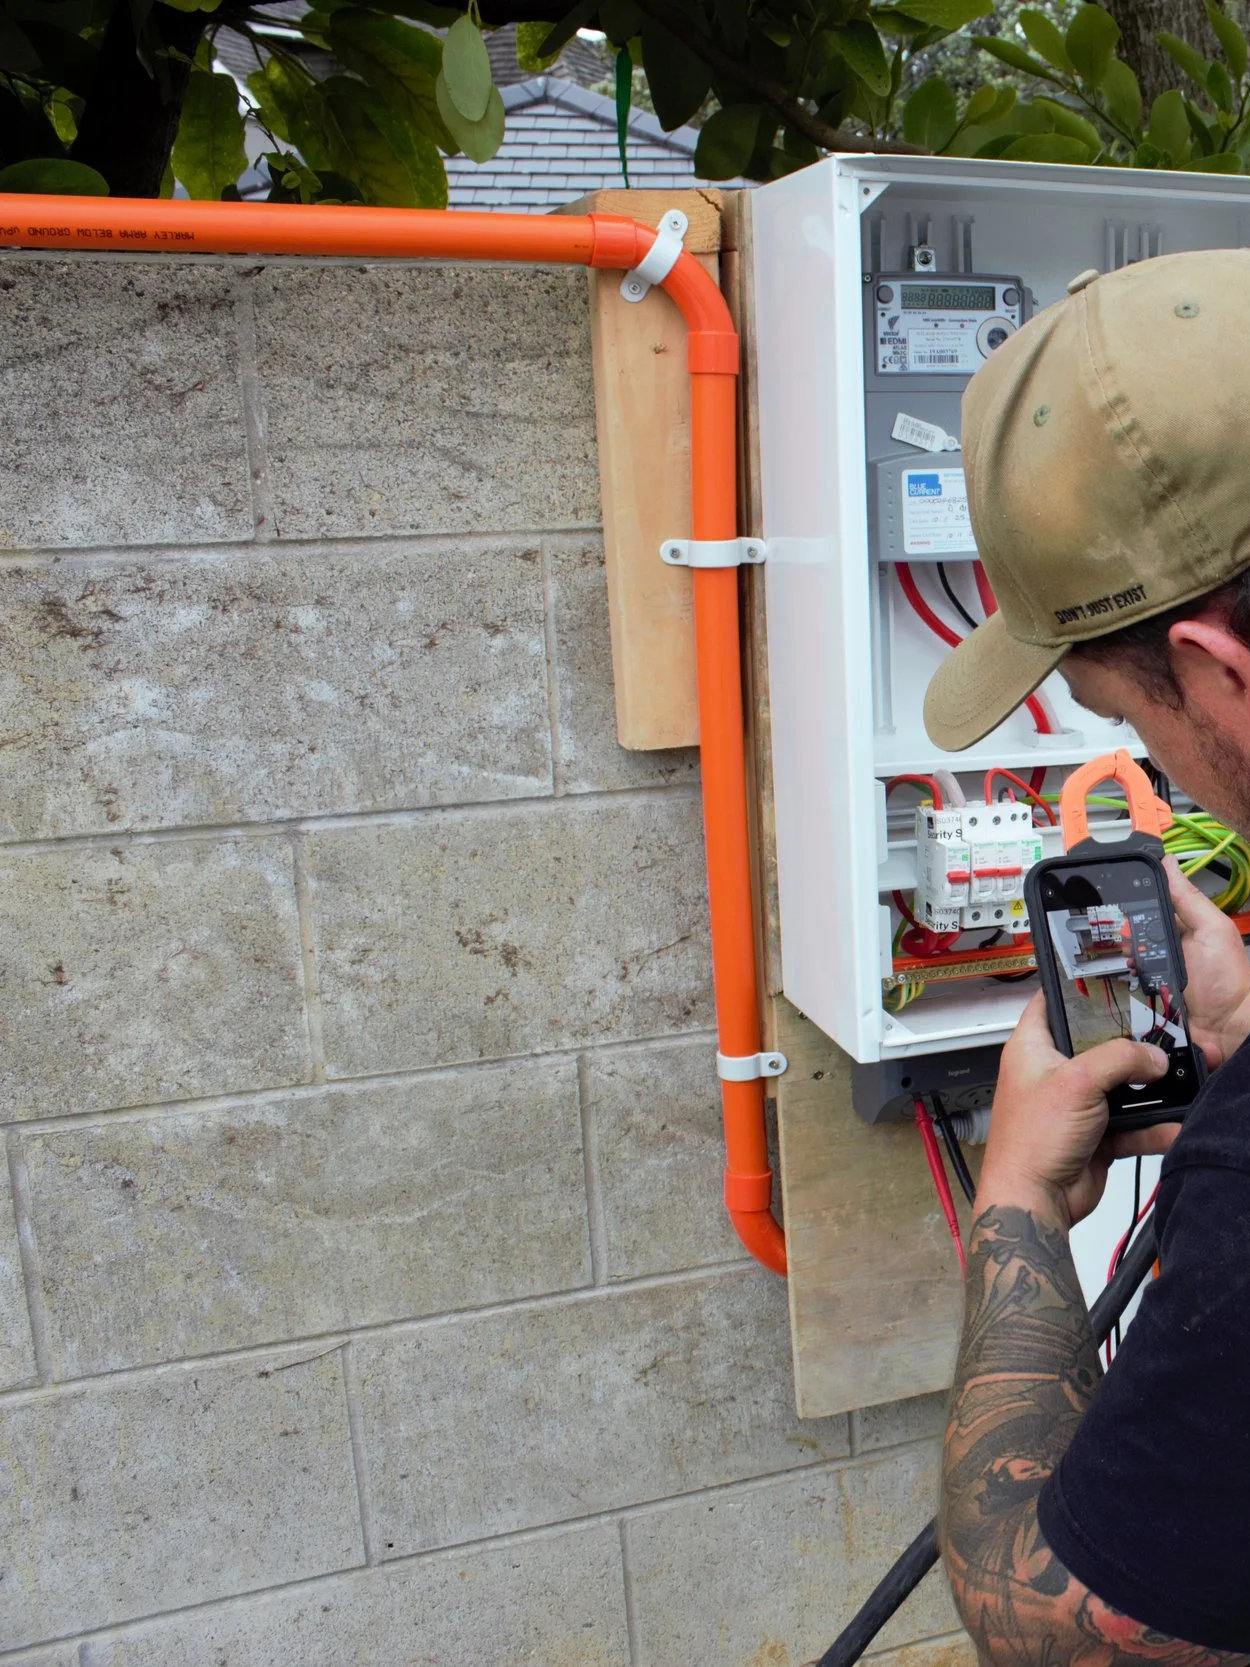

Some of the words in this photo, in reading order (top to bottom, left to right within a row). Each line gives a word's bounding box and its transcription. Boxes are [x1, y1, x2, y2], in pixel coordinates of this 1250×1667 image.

[27, 227, 71, 237] GROUND
[77, 228, 113, 238] BELOW
[119, 230, 148, 239] ARMA
[154, 231, 195, 240] MARLEY
[888, 337, 907, 345] EDMI
[1055, 605, 1086, 624] DON'T
[1086, 595, 1114, 617] JUST
[1113, 584, 1147, 609] EXIST
